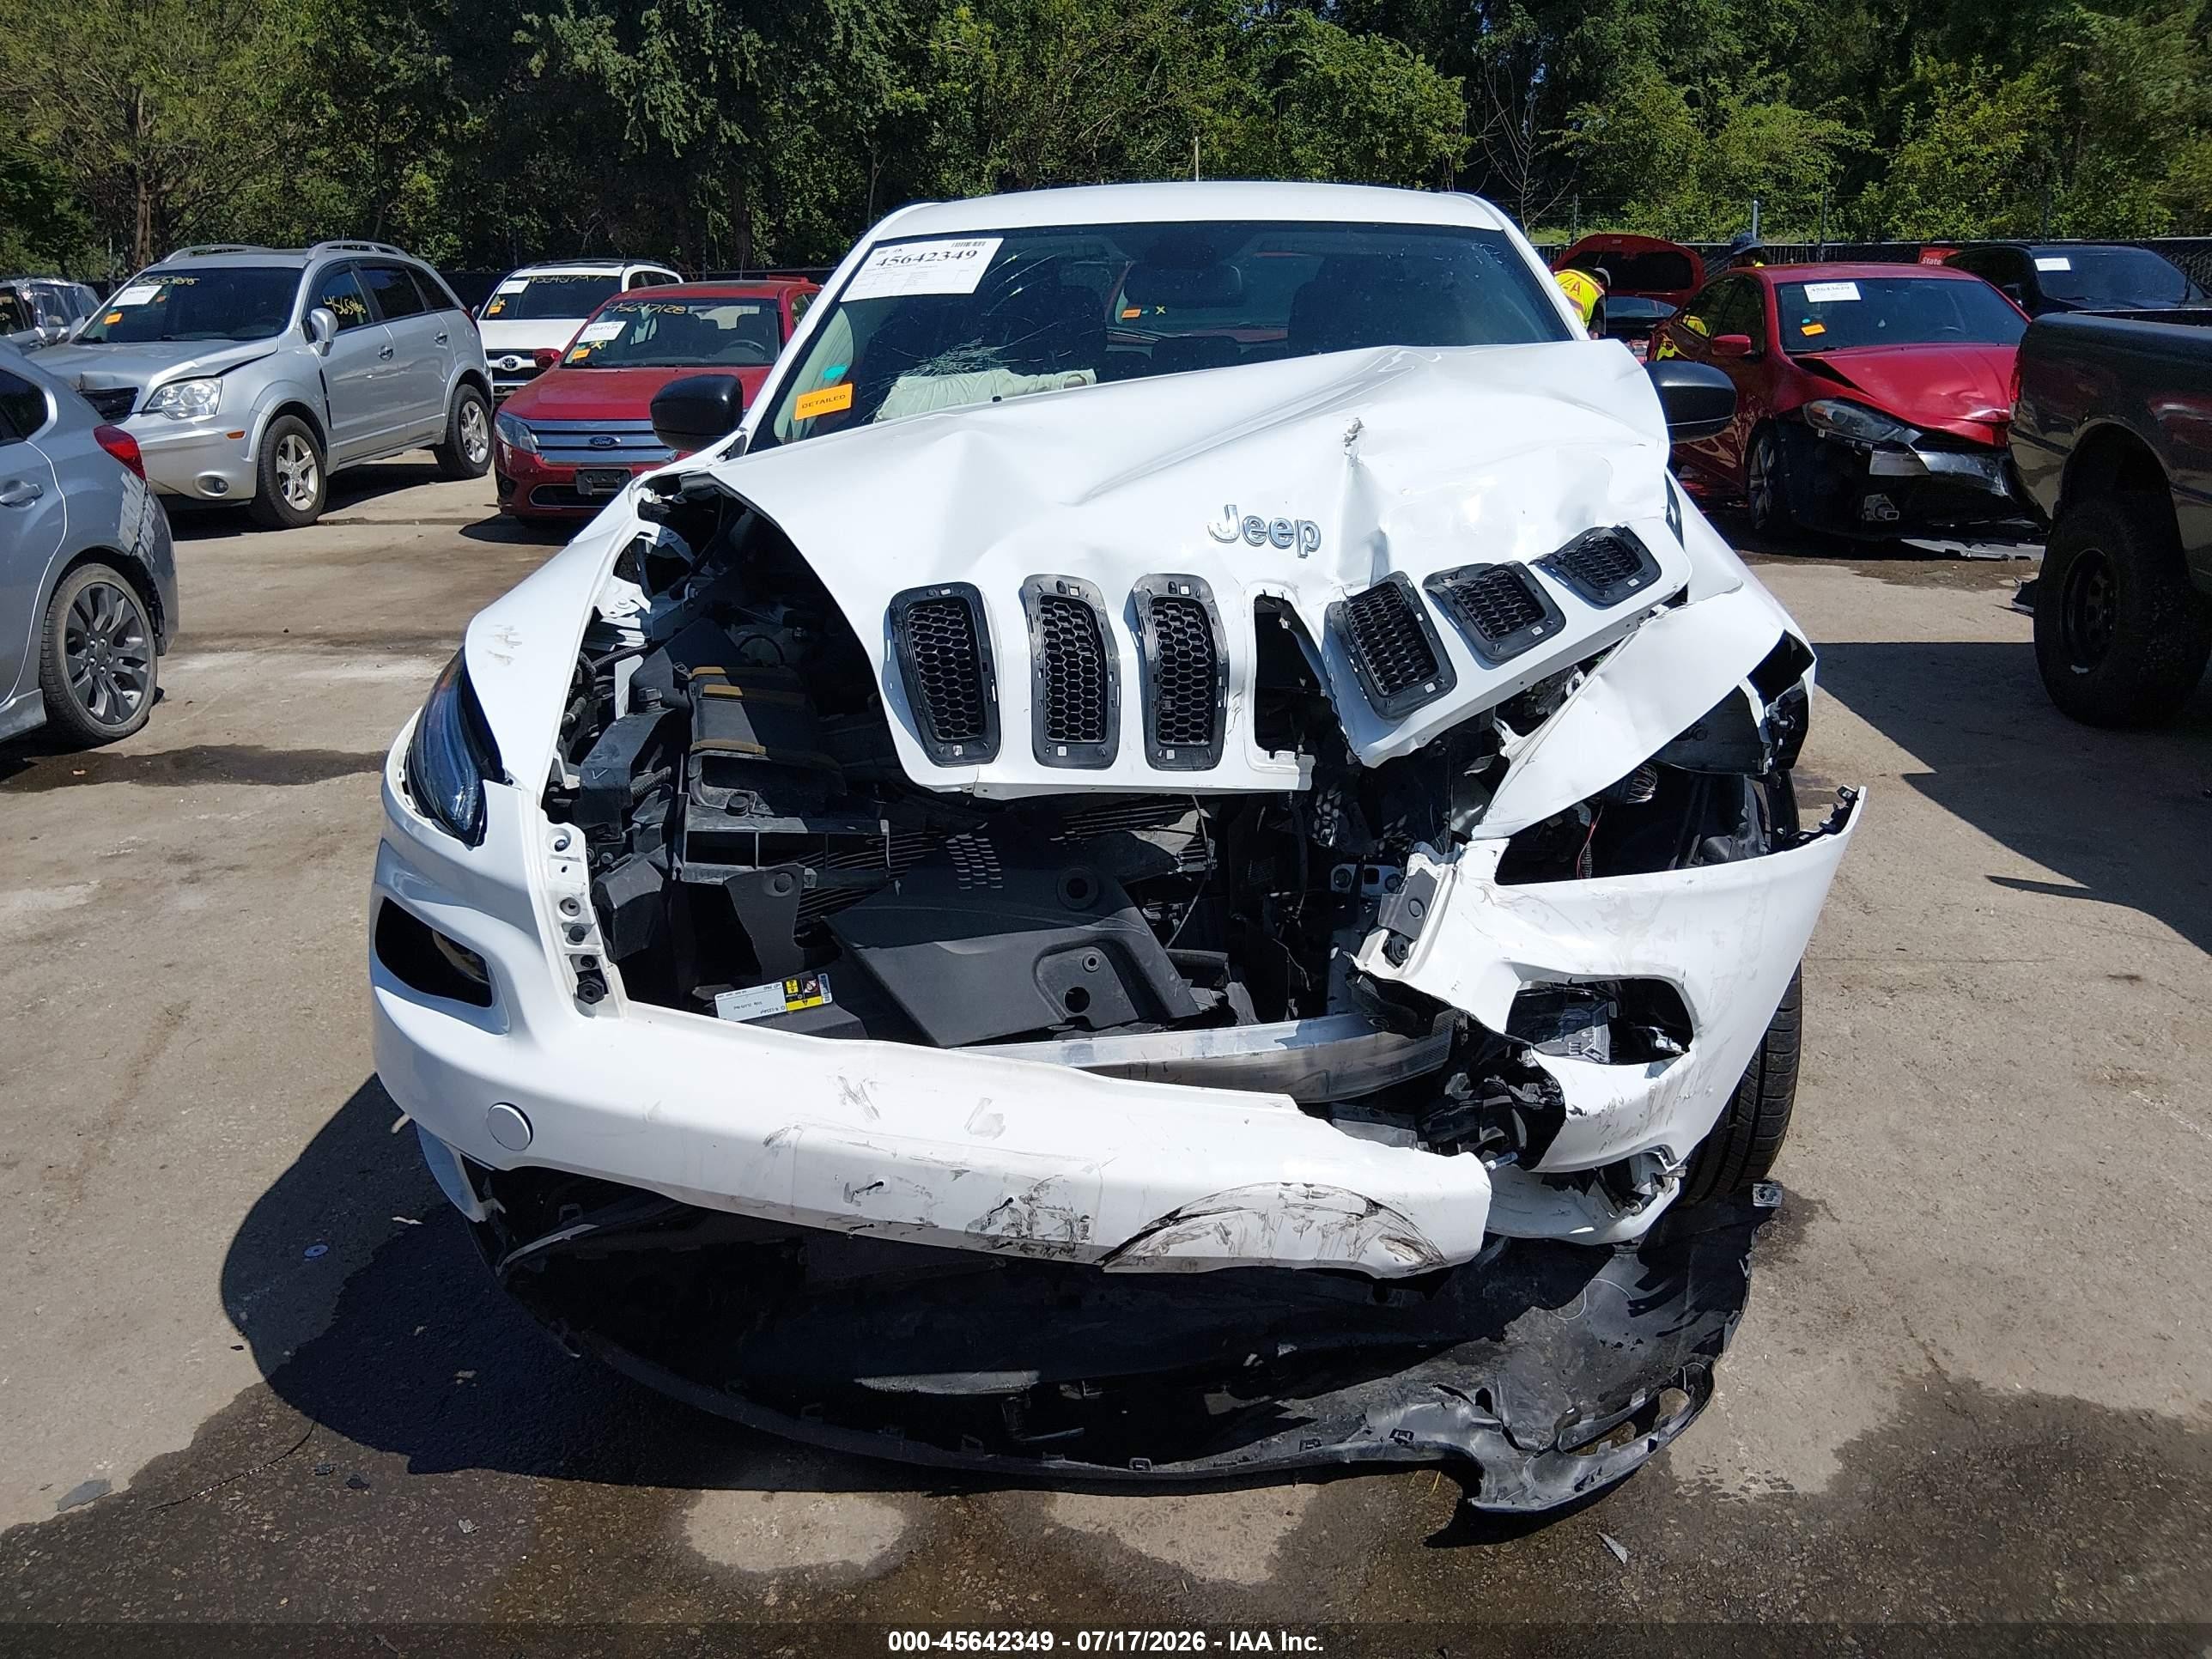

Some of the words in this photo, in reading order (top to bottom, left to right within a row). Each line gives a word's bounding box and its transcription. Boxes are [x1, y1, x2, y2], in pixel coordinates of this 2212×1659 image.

[876, 249, 978, 267] 45642349
[1920, 256, 1942, 266] State
[606, 302, 686, 315] 45647128
[801, 394, 846, 410] DETAILED
[1206, 504, 1322, 558] Jeep
